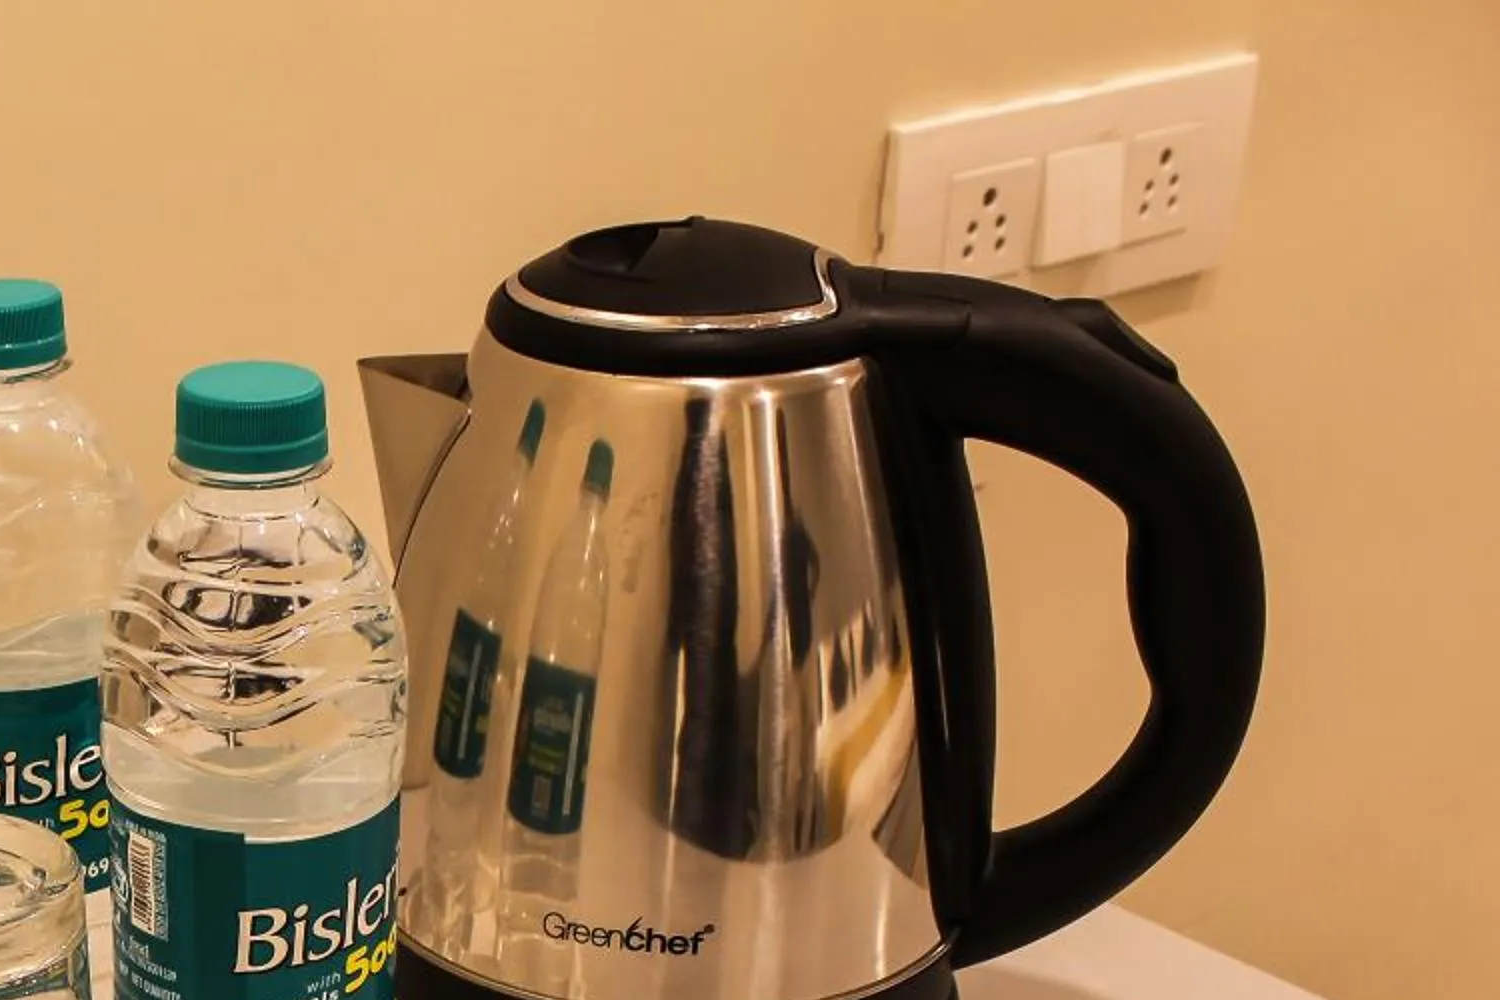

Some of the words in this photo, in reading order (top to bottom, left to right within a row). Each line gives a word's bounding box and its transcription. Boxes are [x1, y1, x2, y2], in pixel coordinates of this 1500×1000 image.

[59, 799, 110, 839] 50
[80, 857, 109, 878] 69
[233, 862, 398, 974] Bisler
[543, 912, 704, 955] Greenchef
[307, 971, 341, 993] with
